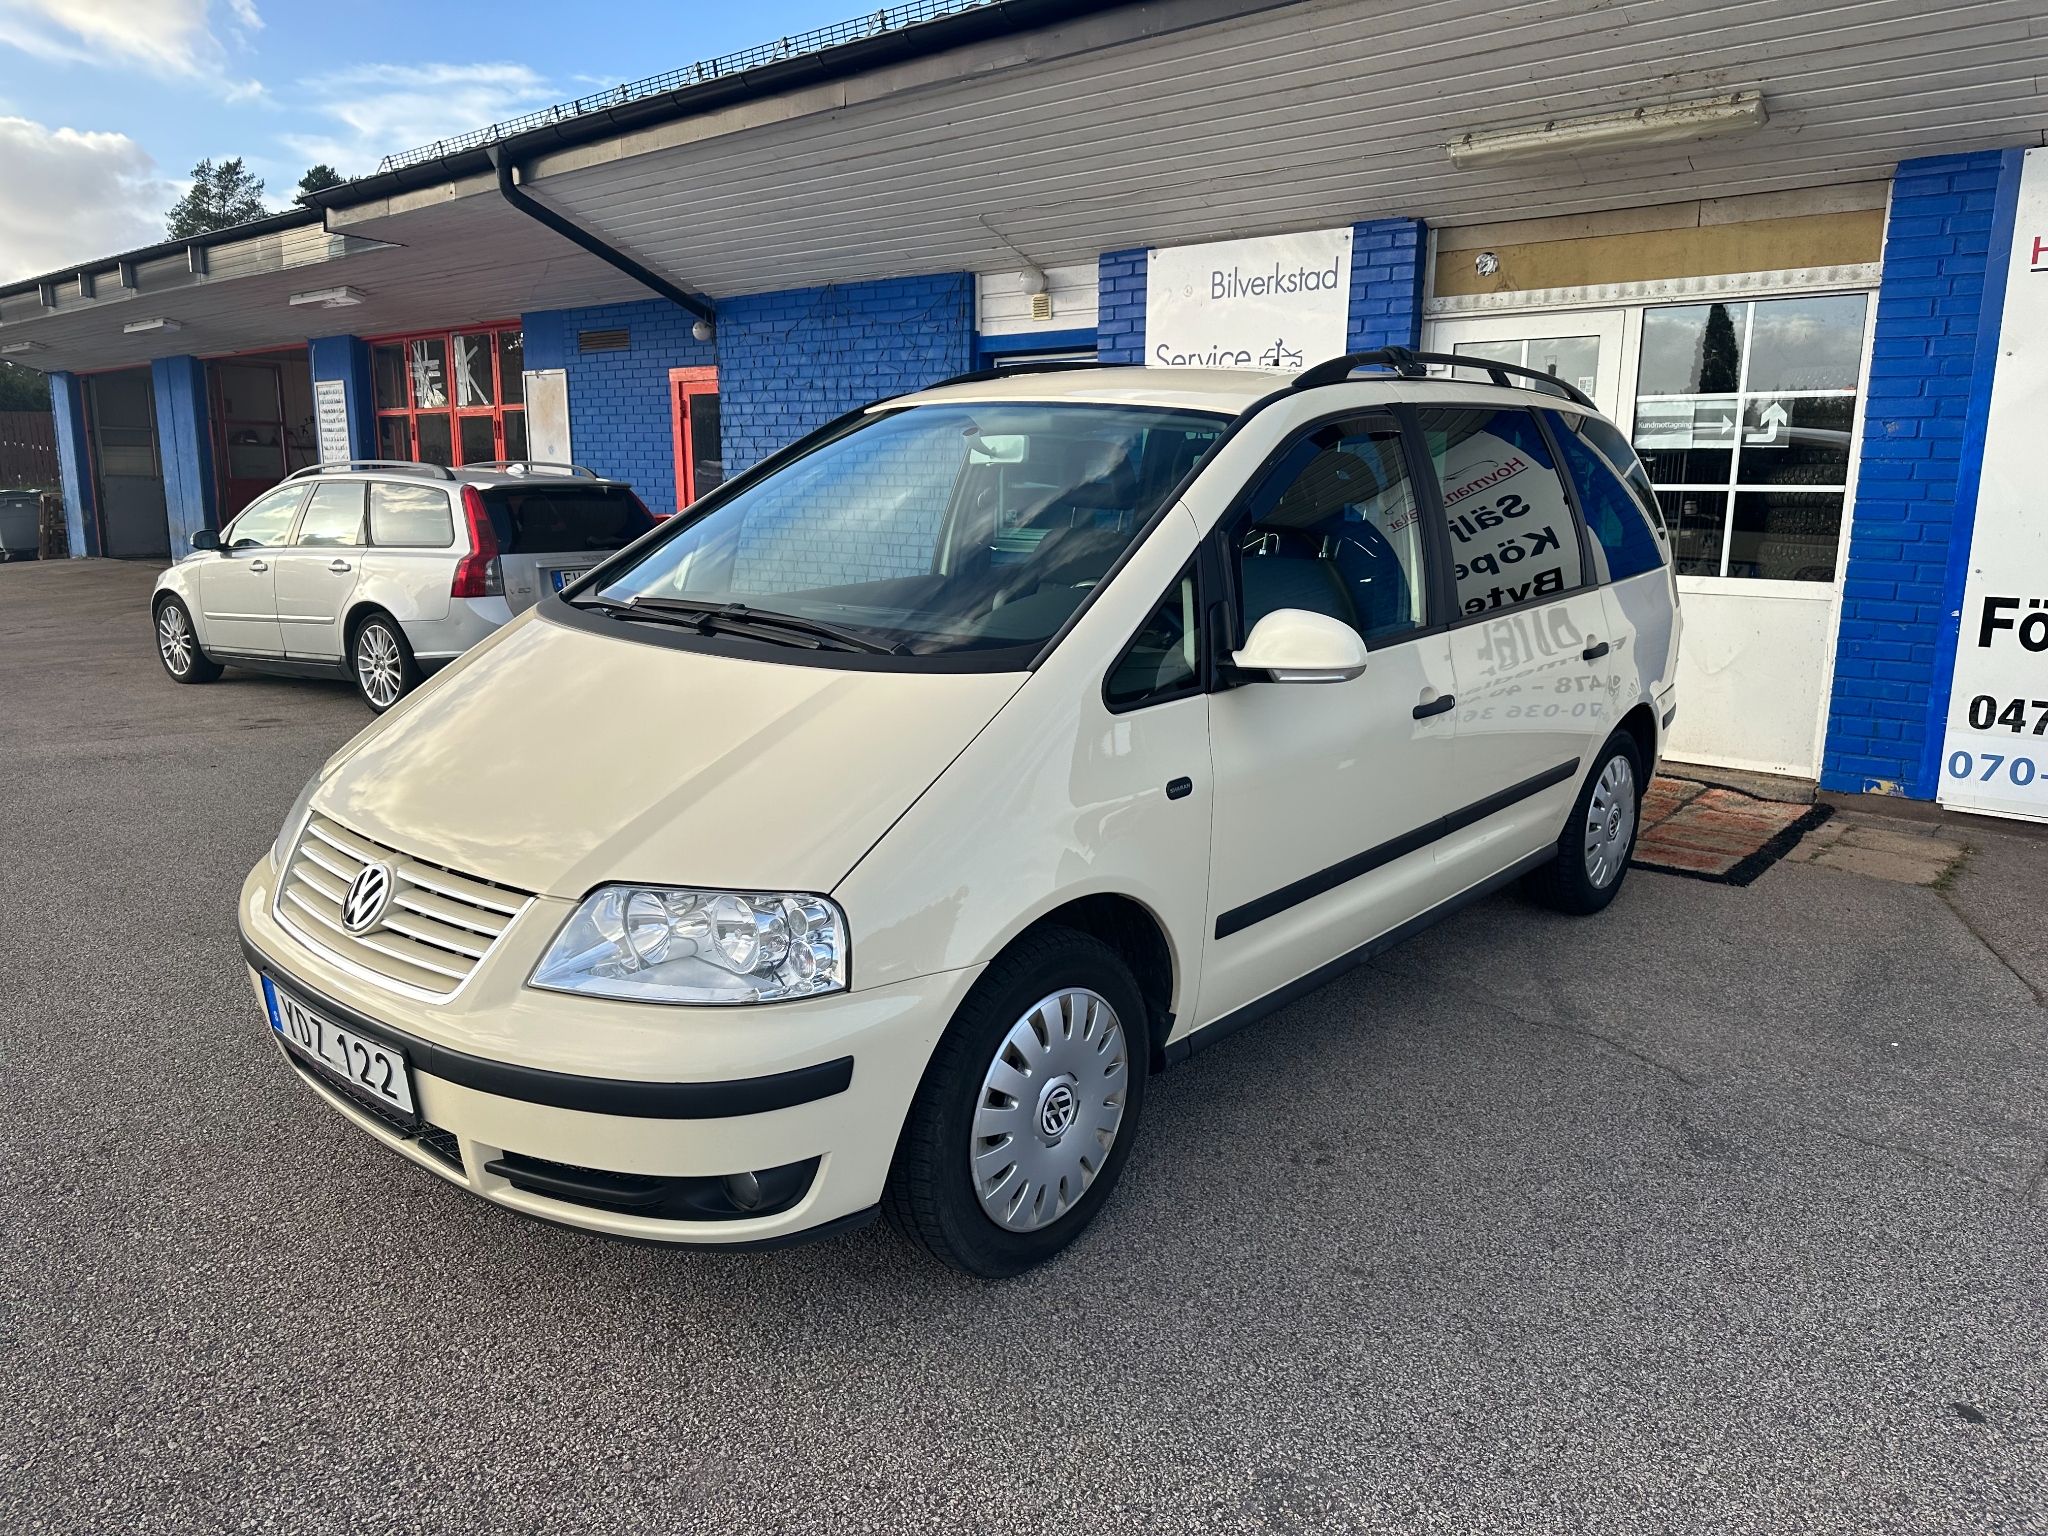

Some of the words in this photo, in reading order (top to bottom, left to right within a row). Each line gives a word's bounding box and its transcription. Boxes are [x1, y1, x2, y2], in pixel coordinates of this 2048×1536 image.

[1210, 255, 1339, 300] Bilverkstad
[1156, 343, 1251, 366] Service
[1637, 420, 1692, 430] Kundmottagning
[1978, 596, 2048, 652] Fö
[1968, 694, 2048, 736] 047
[280, 993, 332, 1064] YDZ
[336, 1032, 398, 1100] 122
